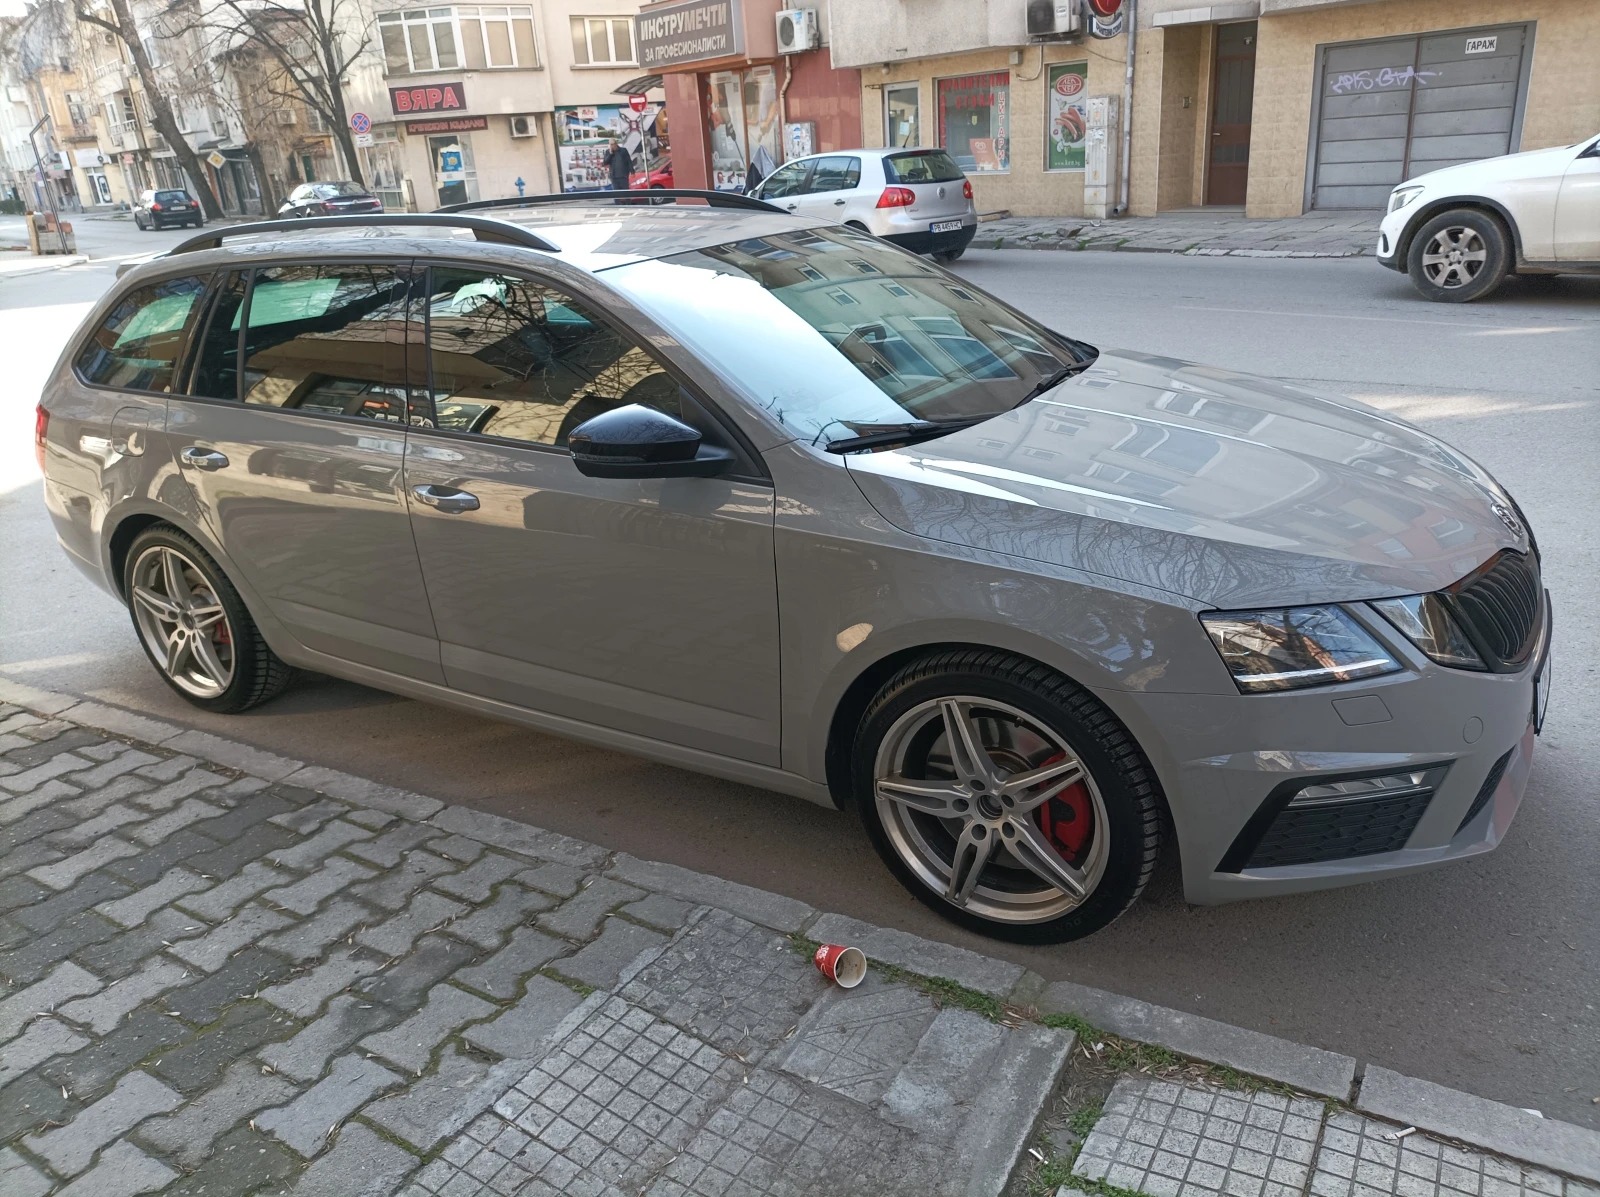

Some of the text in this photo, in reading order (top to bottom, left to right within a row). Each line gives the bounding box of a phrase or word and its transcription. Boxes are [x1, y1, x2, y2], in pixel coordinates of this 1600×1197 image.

[640, 3, 727, 41] ИНСТРУМЕЧТИ
[645, 34, 726, 62] ЗА ПРОФЕСИОНАЛИСТИ
[1466, 39, 1496, 52] ГАРАЖ
[940, 72, 1010, 92] ХРАНИТЕЛНИ
[395, 87, 460, 111] ВЯРА
[956, 93, 995, 109] СТОКИ
[997, 91, 1006, 161] ЦИГАРИ
[934, 223, 942, 232] PB
